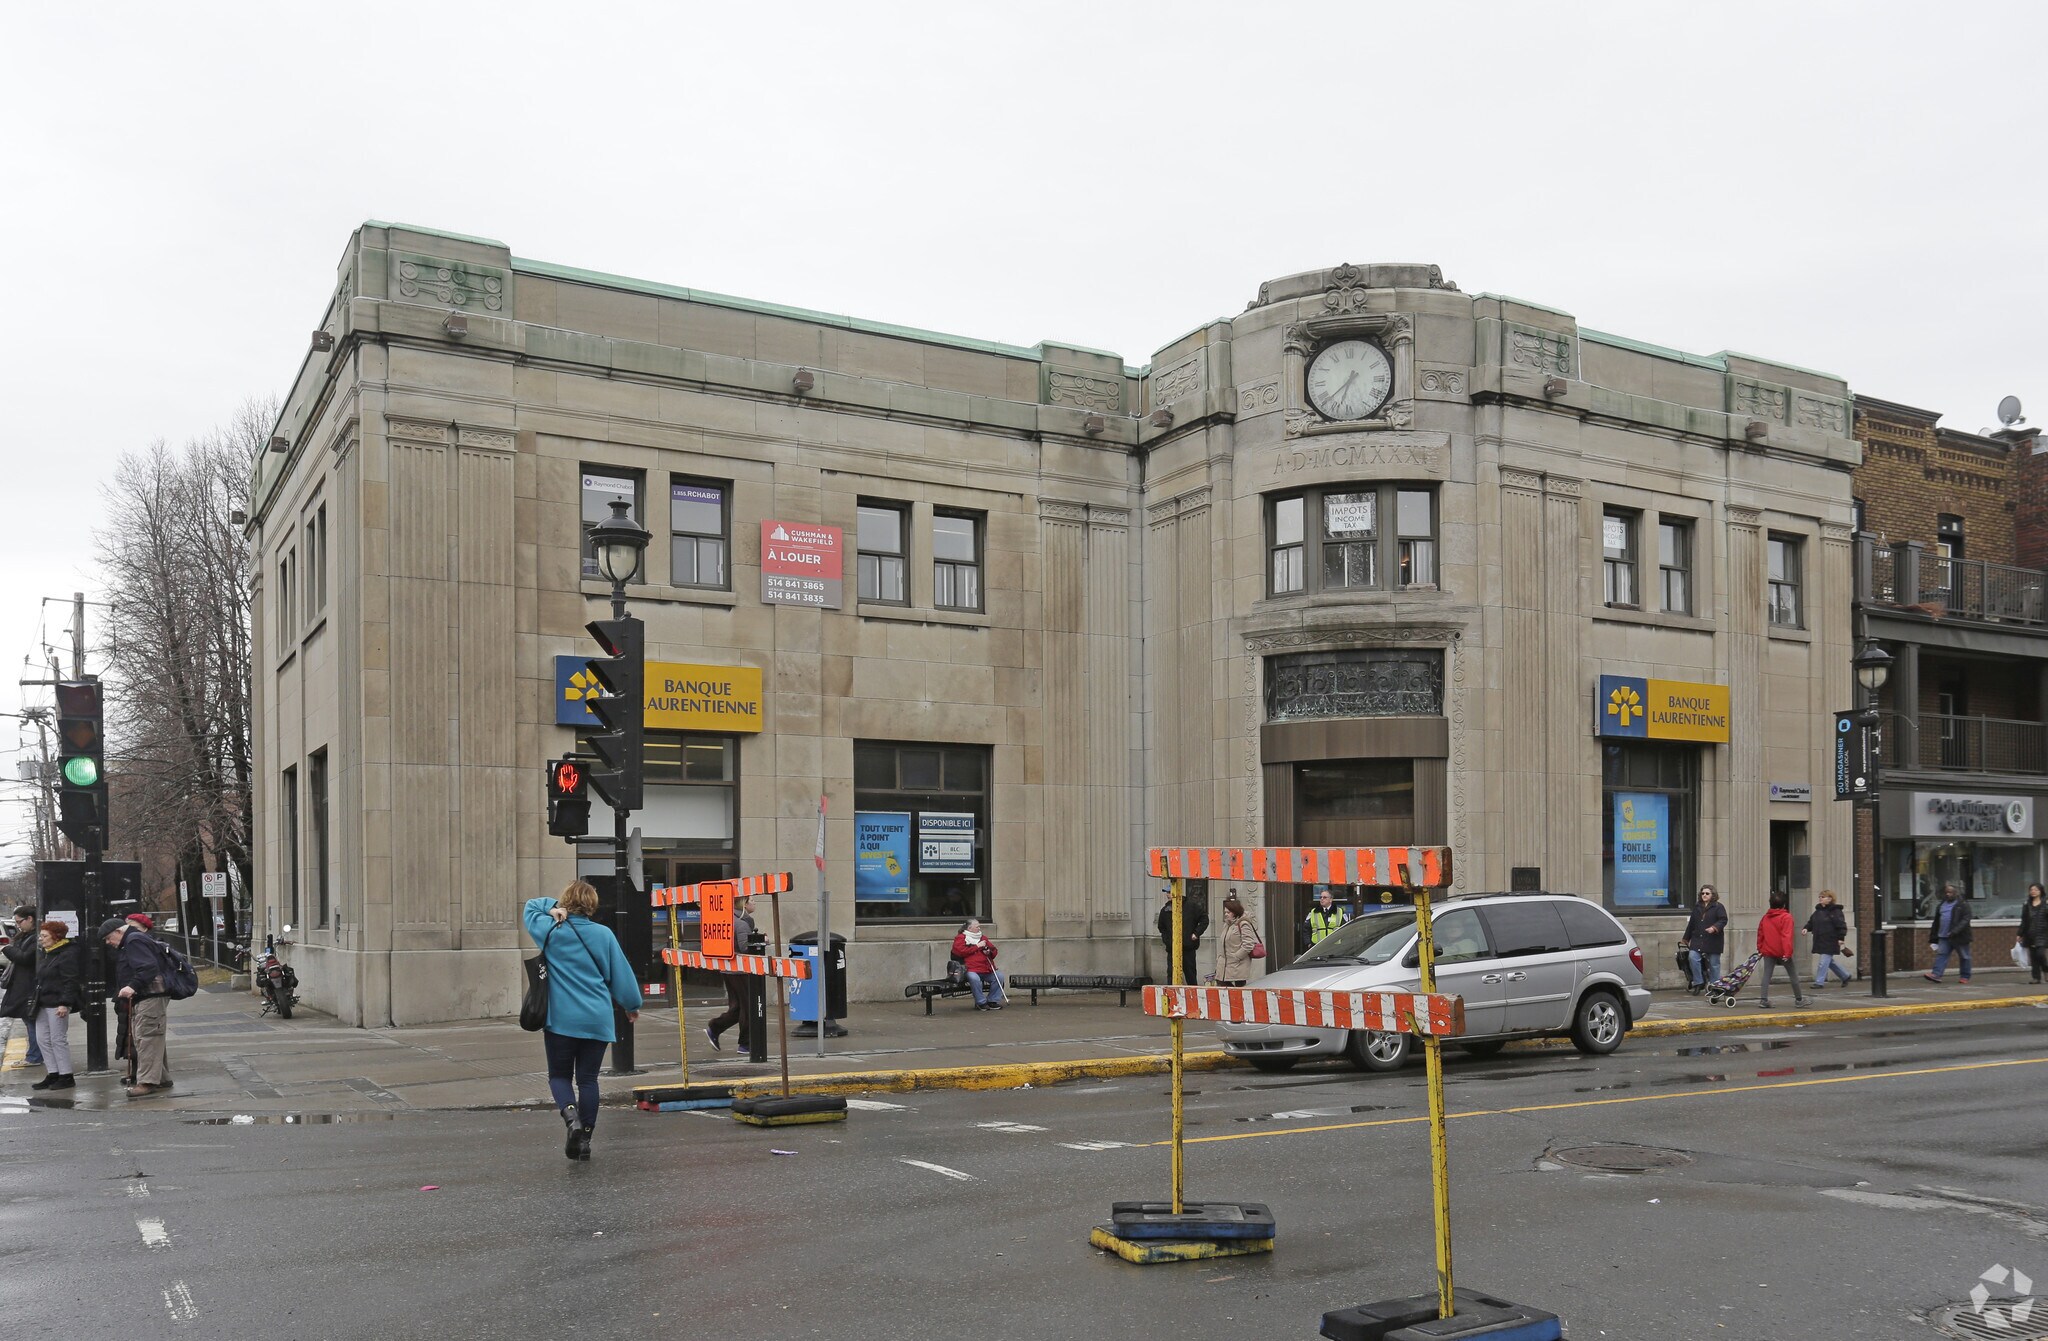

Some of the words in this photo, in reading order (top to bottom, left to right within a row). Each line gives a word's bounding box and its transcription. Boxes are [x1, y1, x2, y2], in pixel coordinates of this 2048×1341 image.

[594, 480, 616, 489] Raymond
[1335, 515, 1365, 523] INCOME
[791, 530, 826, 539] CUSHMAN
[791, 536, 833, 546] WAKEFIELD
[768, 548, 777, 560] À
[780, 551, 821, 565] LOUER
[768, 579, 783, 587] 514
[785, 580, 801, 588] 841
[803, 582, 825, 591] 3865
[768, 591, 783, 599] 514
[785, 592, 801, 601] 841
[803, 594, 824, 603] 3835
[664, 679, 732, 697] BANQUE
[644, 698, 757, 715] AURENTIENNE
[1668, 695, 1710, 711] BANQUE
[1652, 711, 1726, 728] LAURENTIENNE
[922, 819, 961, 827] DISPONIBLE
[860, 825, 880, 833] TOUT
[881, 825, 904, 833] VIENT
[867, 842, 880, 851] QUI
[1622, 843, 1641, 852] FONT
[1642, 844, 1651, 852] LE
[1622, 854, 1656, 863] BONHEUR
[709, 895, 724, 911] RUE
[703, 920, 731, 940] BARRÉE
